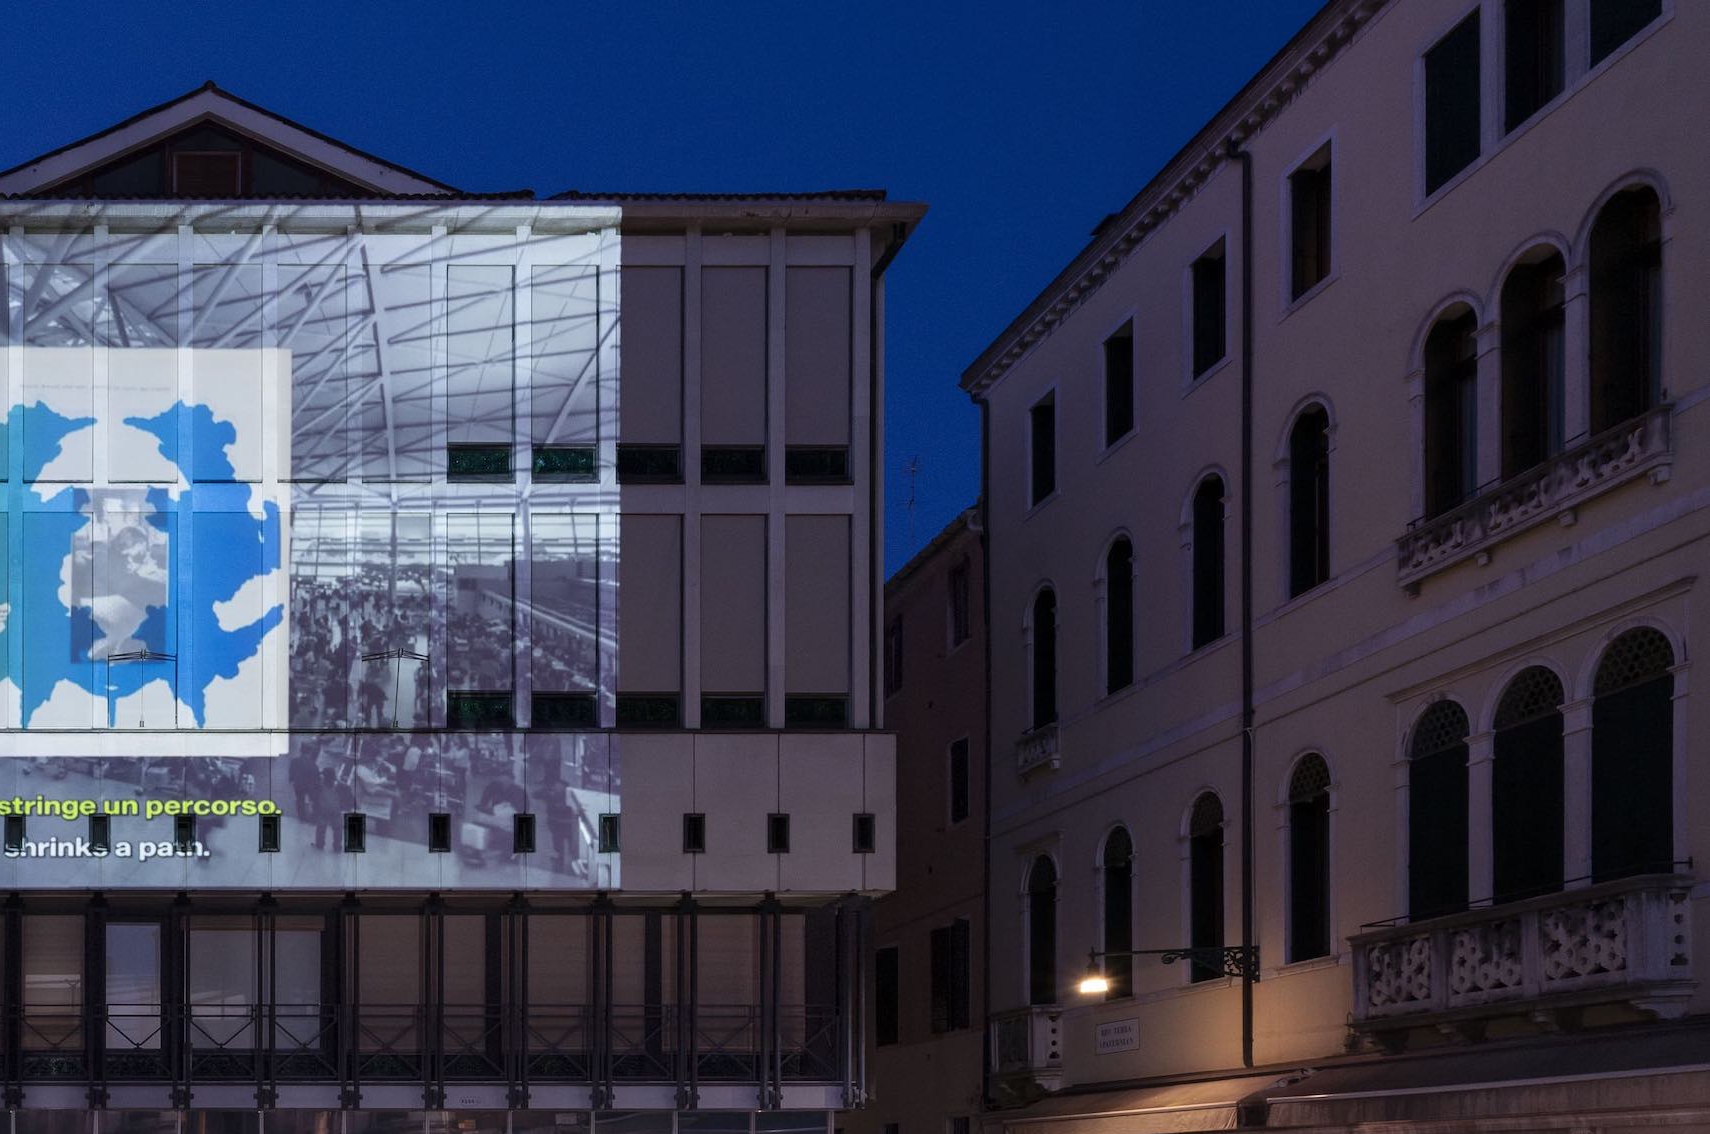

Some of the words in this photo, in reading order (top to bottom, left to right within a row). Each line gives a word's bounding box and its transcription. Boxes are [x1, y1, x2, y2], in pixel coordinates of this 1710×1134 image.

[102, 799, 139, 816] un
[145, 799, 282, 820] percorso.
[115, 841, 132, 858] a
